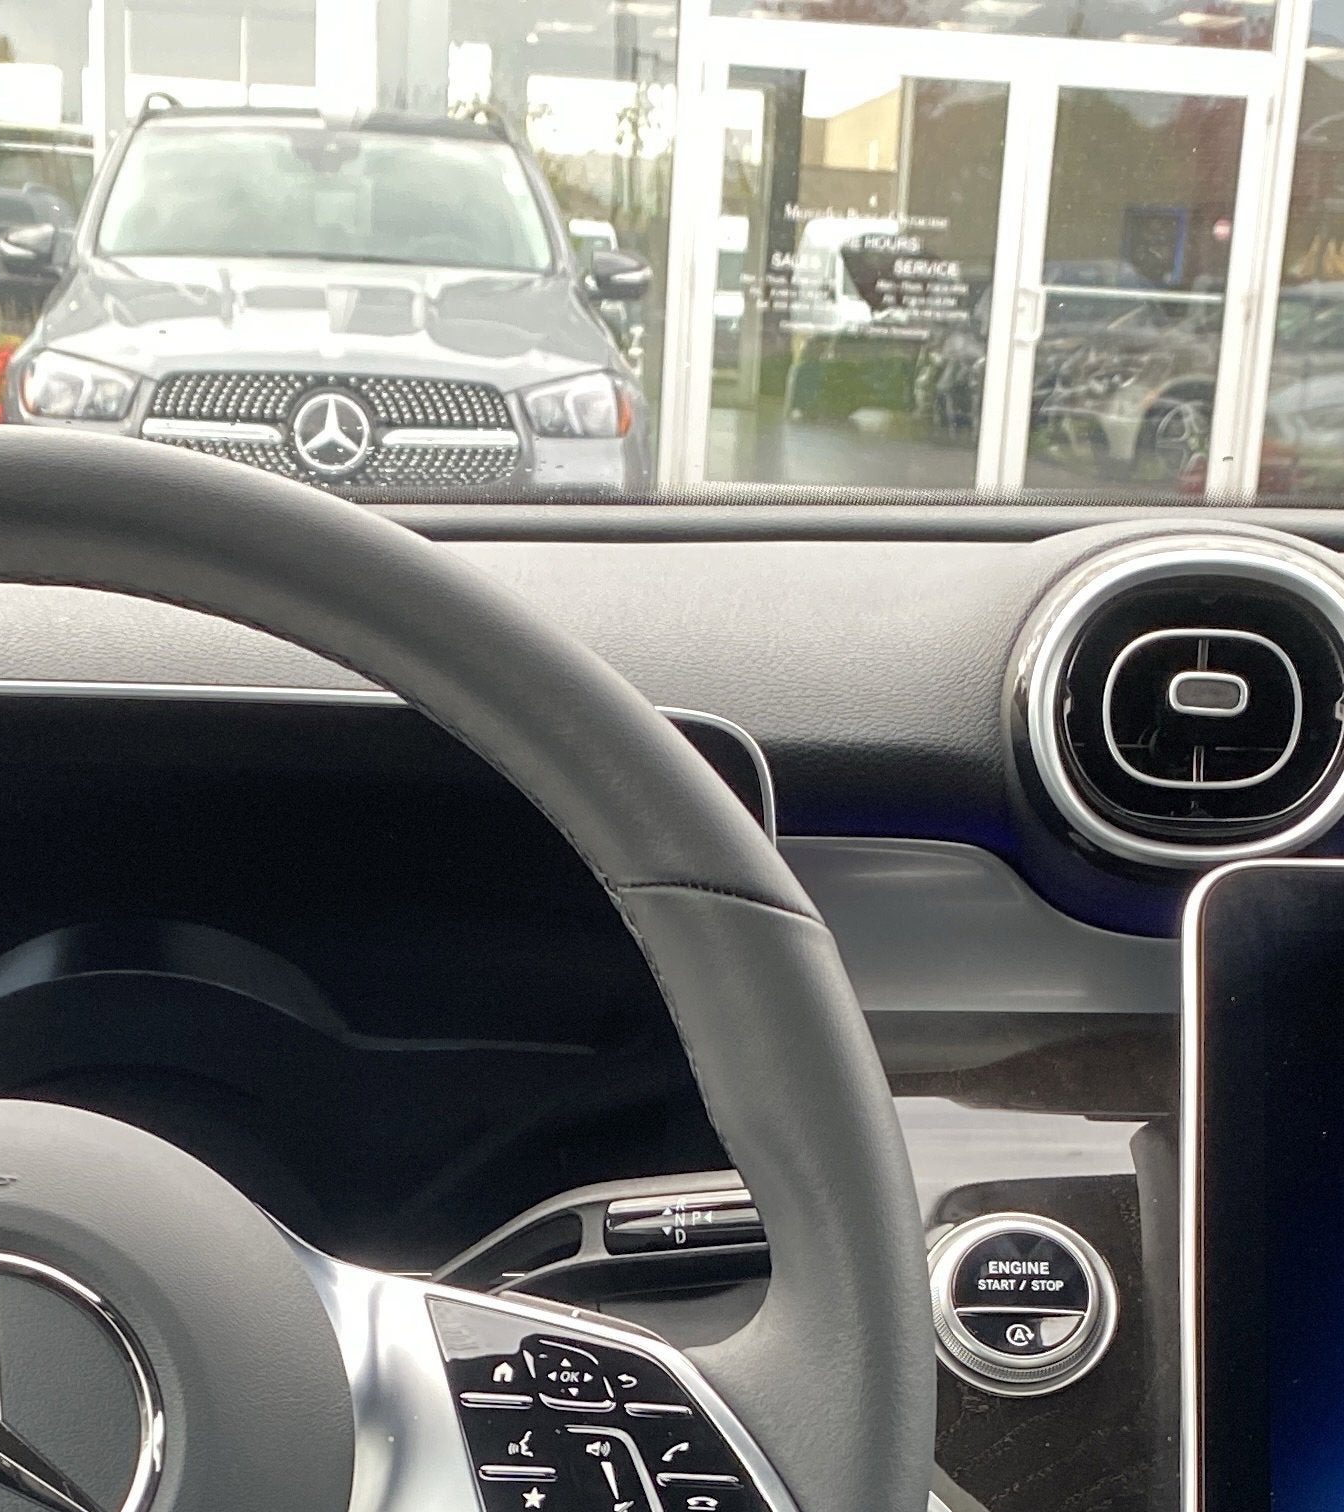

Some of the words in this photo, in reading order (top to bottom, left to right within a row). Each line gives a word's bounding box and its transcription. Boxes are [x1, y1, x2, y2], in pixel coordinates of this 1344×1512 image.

[675, 1228, 687, 1244] D
[988, 1261, 1050, 1275] ENGINE
[978, 1279, 1016, 1291] START
[1031, 1280, 1064, 1291] STOP
[560, 1371, 580, 1383] OK
